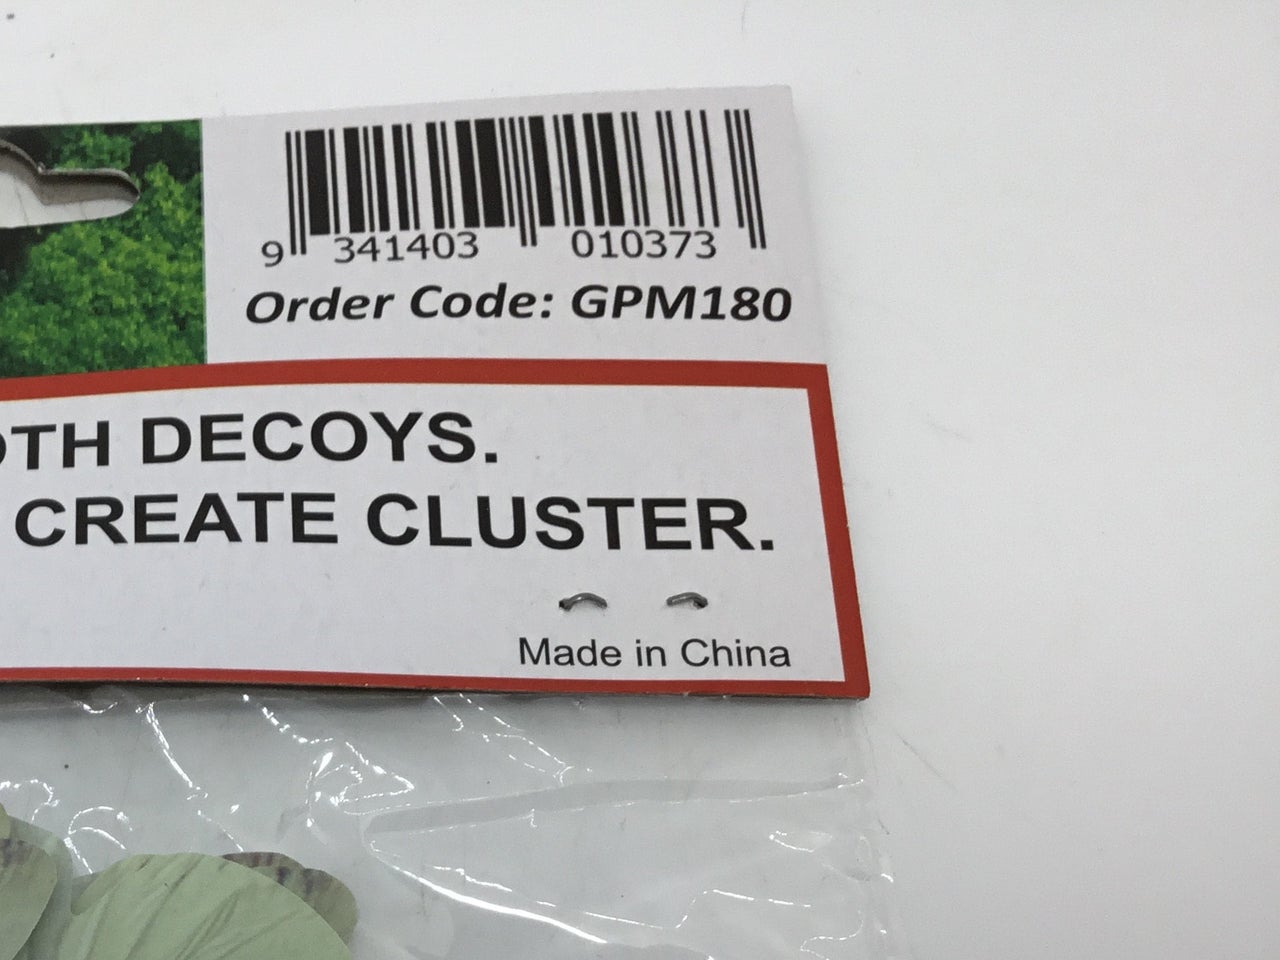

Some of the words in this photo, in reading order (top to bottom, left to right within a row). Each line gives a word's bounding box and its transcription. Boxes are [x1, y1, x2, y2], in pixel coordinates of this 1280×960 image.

[261, 241, 284, 267] 9
[334, 231, 479, 263] 341403
[571, 231, 717, 258] 010373
[245, 287, 394, 324] Order
[410, 282, 553, 319] Code:
[571, 284, 793, 323] GPM180
[140, 410, 498, 464] DECOYS.
[14, 491, 338, 548] CREATE
[366, 492, 774, 552] CLUSTER.
[519, 637, 621, 667] Made
[635, 638, 666, 667] in
[681, 637, 791, 668] China
